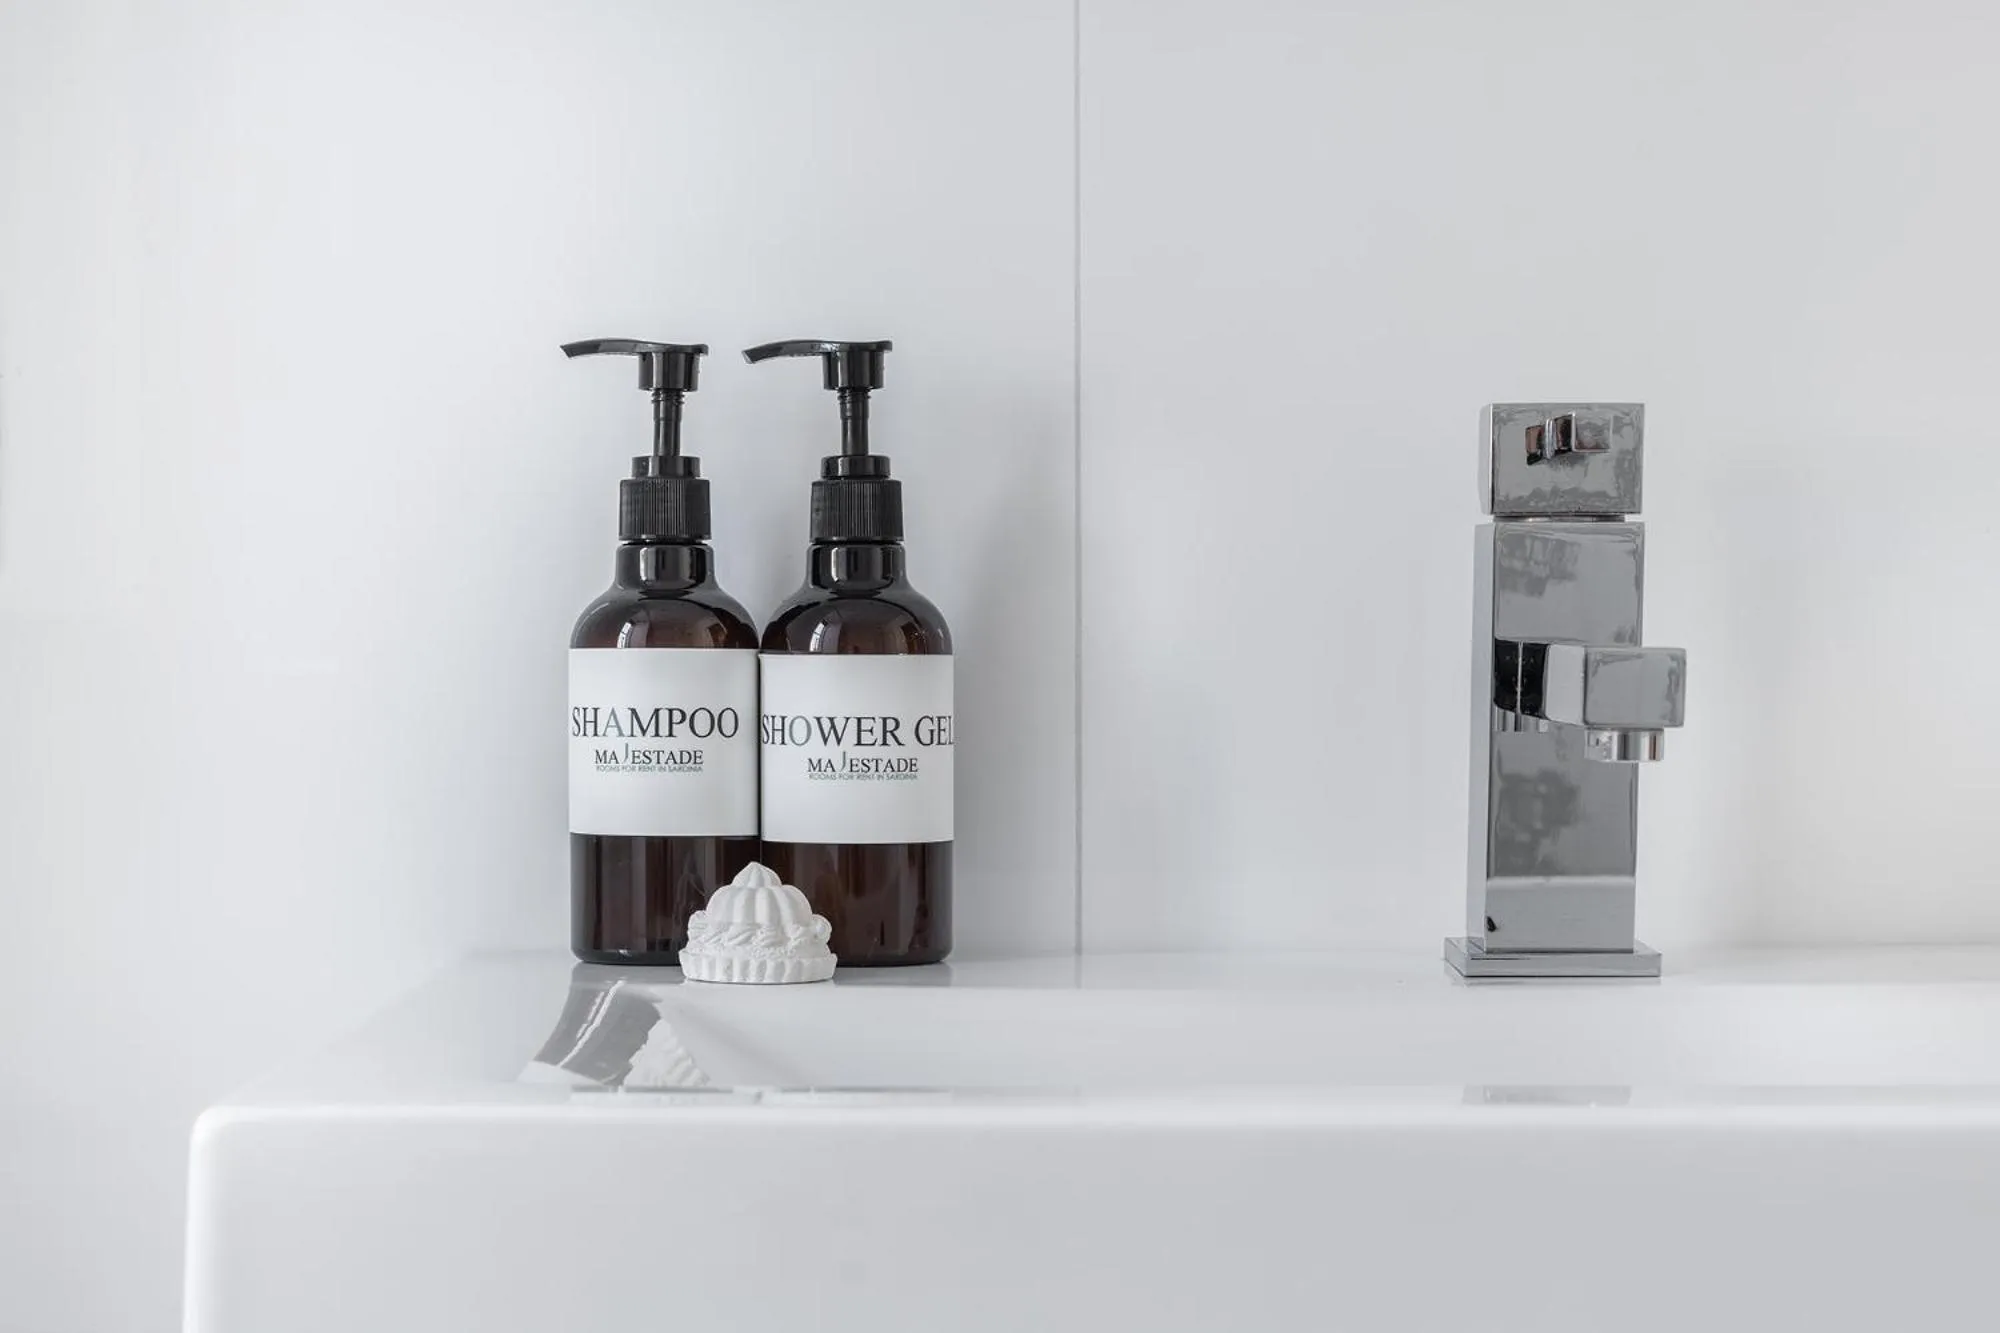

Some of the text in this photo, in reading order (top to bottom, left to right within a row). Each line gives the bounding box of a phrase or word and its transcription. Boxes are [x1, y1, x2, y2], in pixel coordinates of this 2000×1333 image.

[572, 706, 739, 738] SHAMPOO
[762, 714, 906, 746] SHOWER
[595, 742, 704, 765] MAJESTADE
[807, 751, 918, 774] MAJESTADE
[622, 765, 636, 773] FOR
[658, 765, 667, 773] IN
[839, 773, 854, 781] FOR
[877, 773, 885, 781] IN
